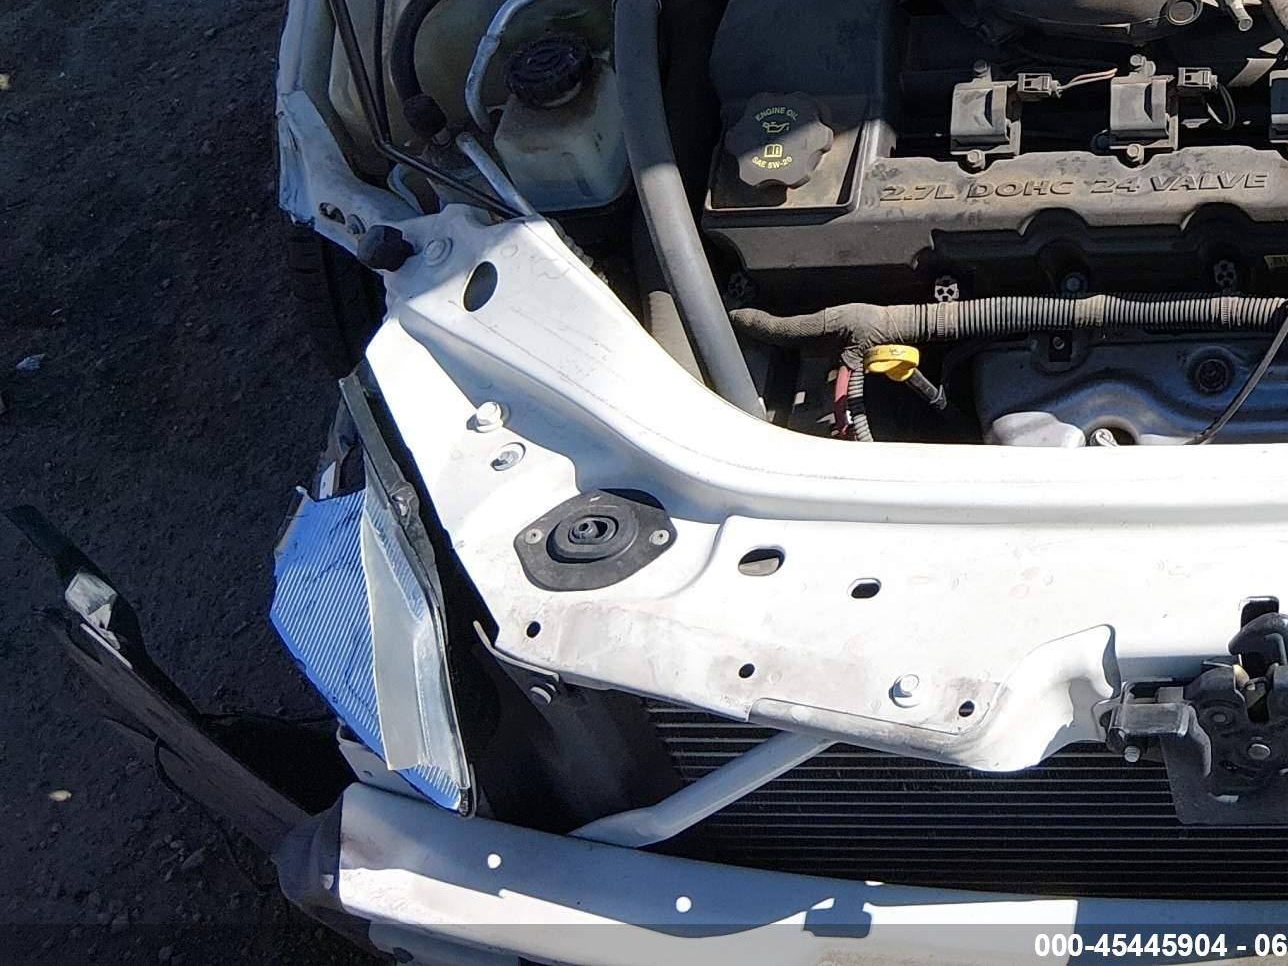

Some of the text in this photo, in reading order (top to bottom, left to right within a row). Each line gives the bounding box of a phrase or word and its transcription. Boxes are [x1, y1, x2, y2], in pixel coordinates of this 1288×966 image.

[754, 106, 799, 122] ENGINE OIL
[751, 156, 766, 168] SAE
[880, 172, 1270, 203] 2.7L DOHC 24 VALVE
